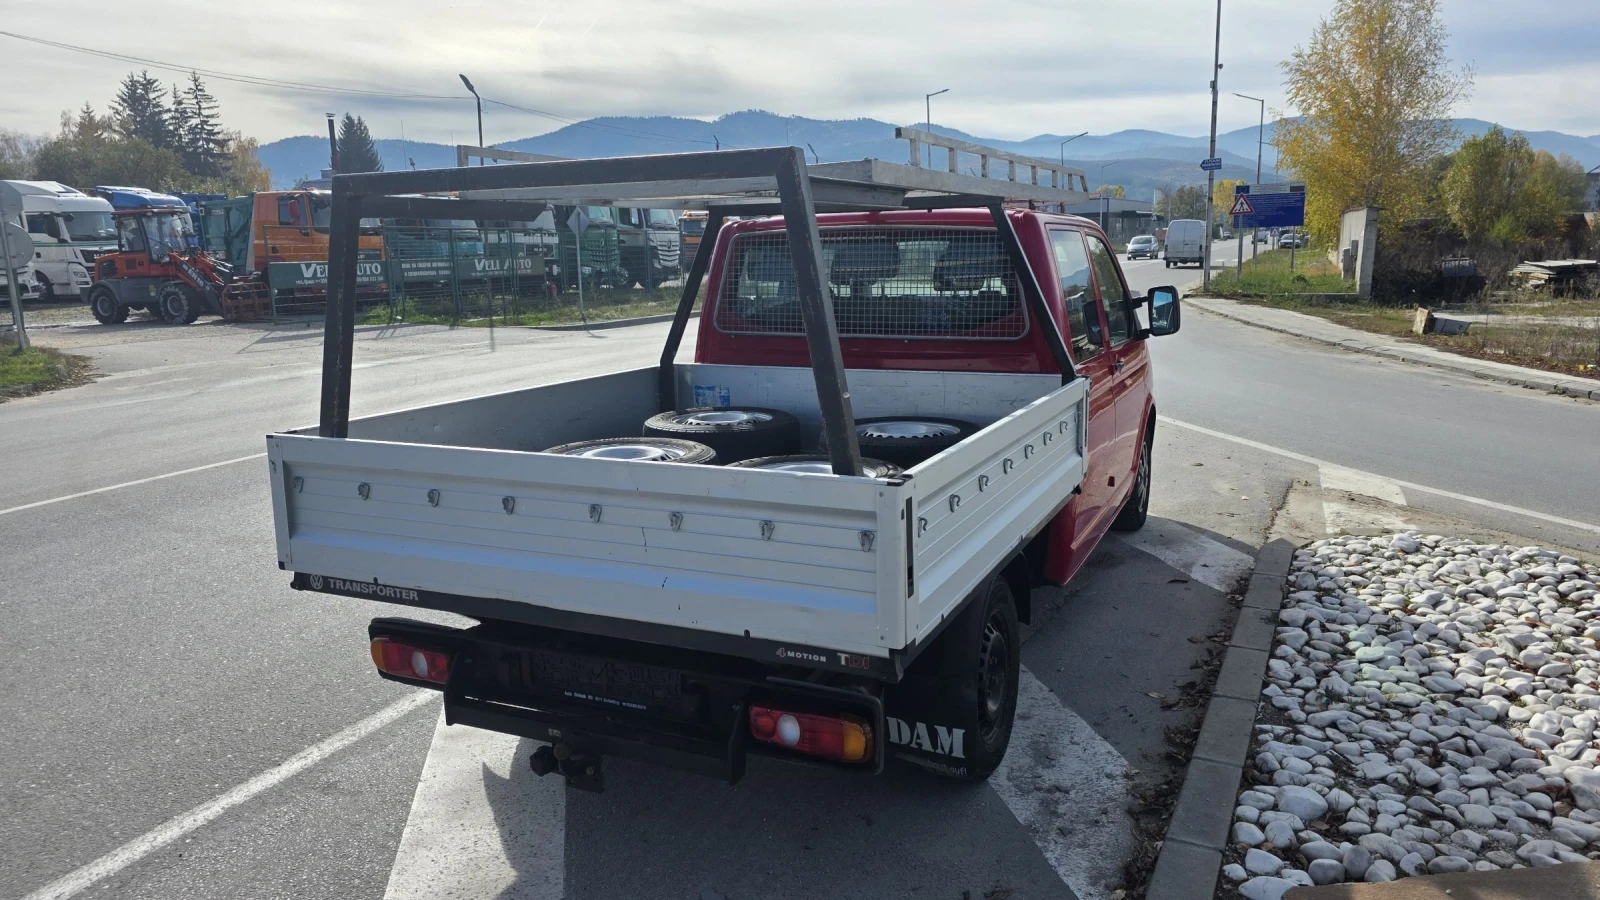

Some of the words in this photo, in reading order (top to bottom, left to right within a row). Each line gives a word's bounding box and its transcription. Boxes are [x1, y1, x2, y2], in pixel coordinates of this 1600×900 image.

[356, 262, 381, 276] UTO
[474, 258, 500, 271] VELI
[328, 578, 419, 601] TRANSPORTER
[837, 652, 870, 669] TDI
[886, 716, 966, 759] DAM
